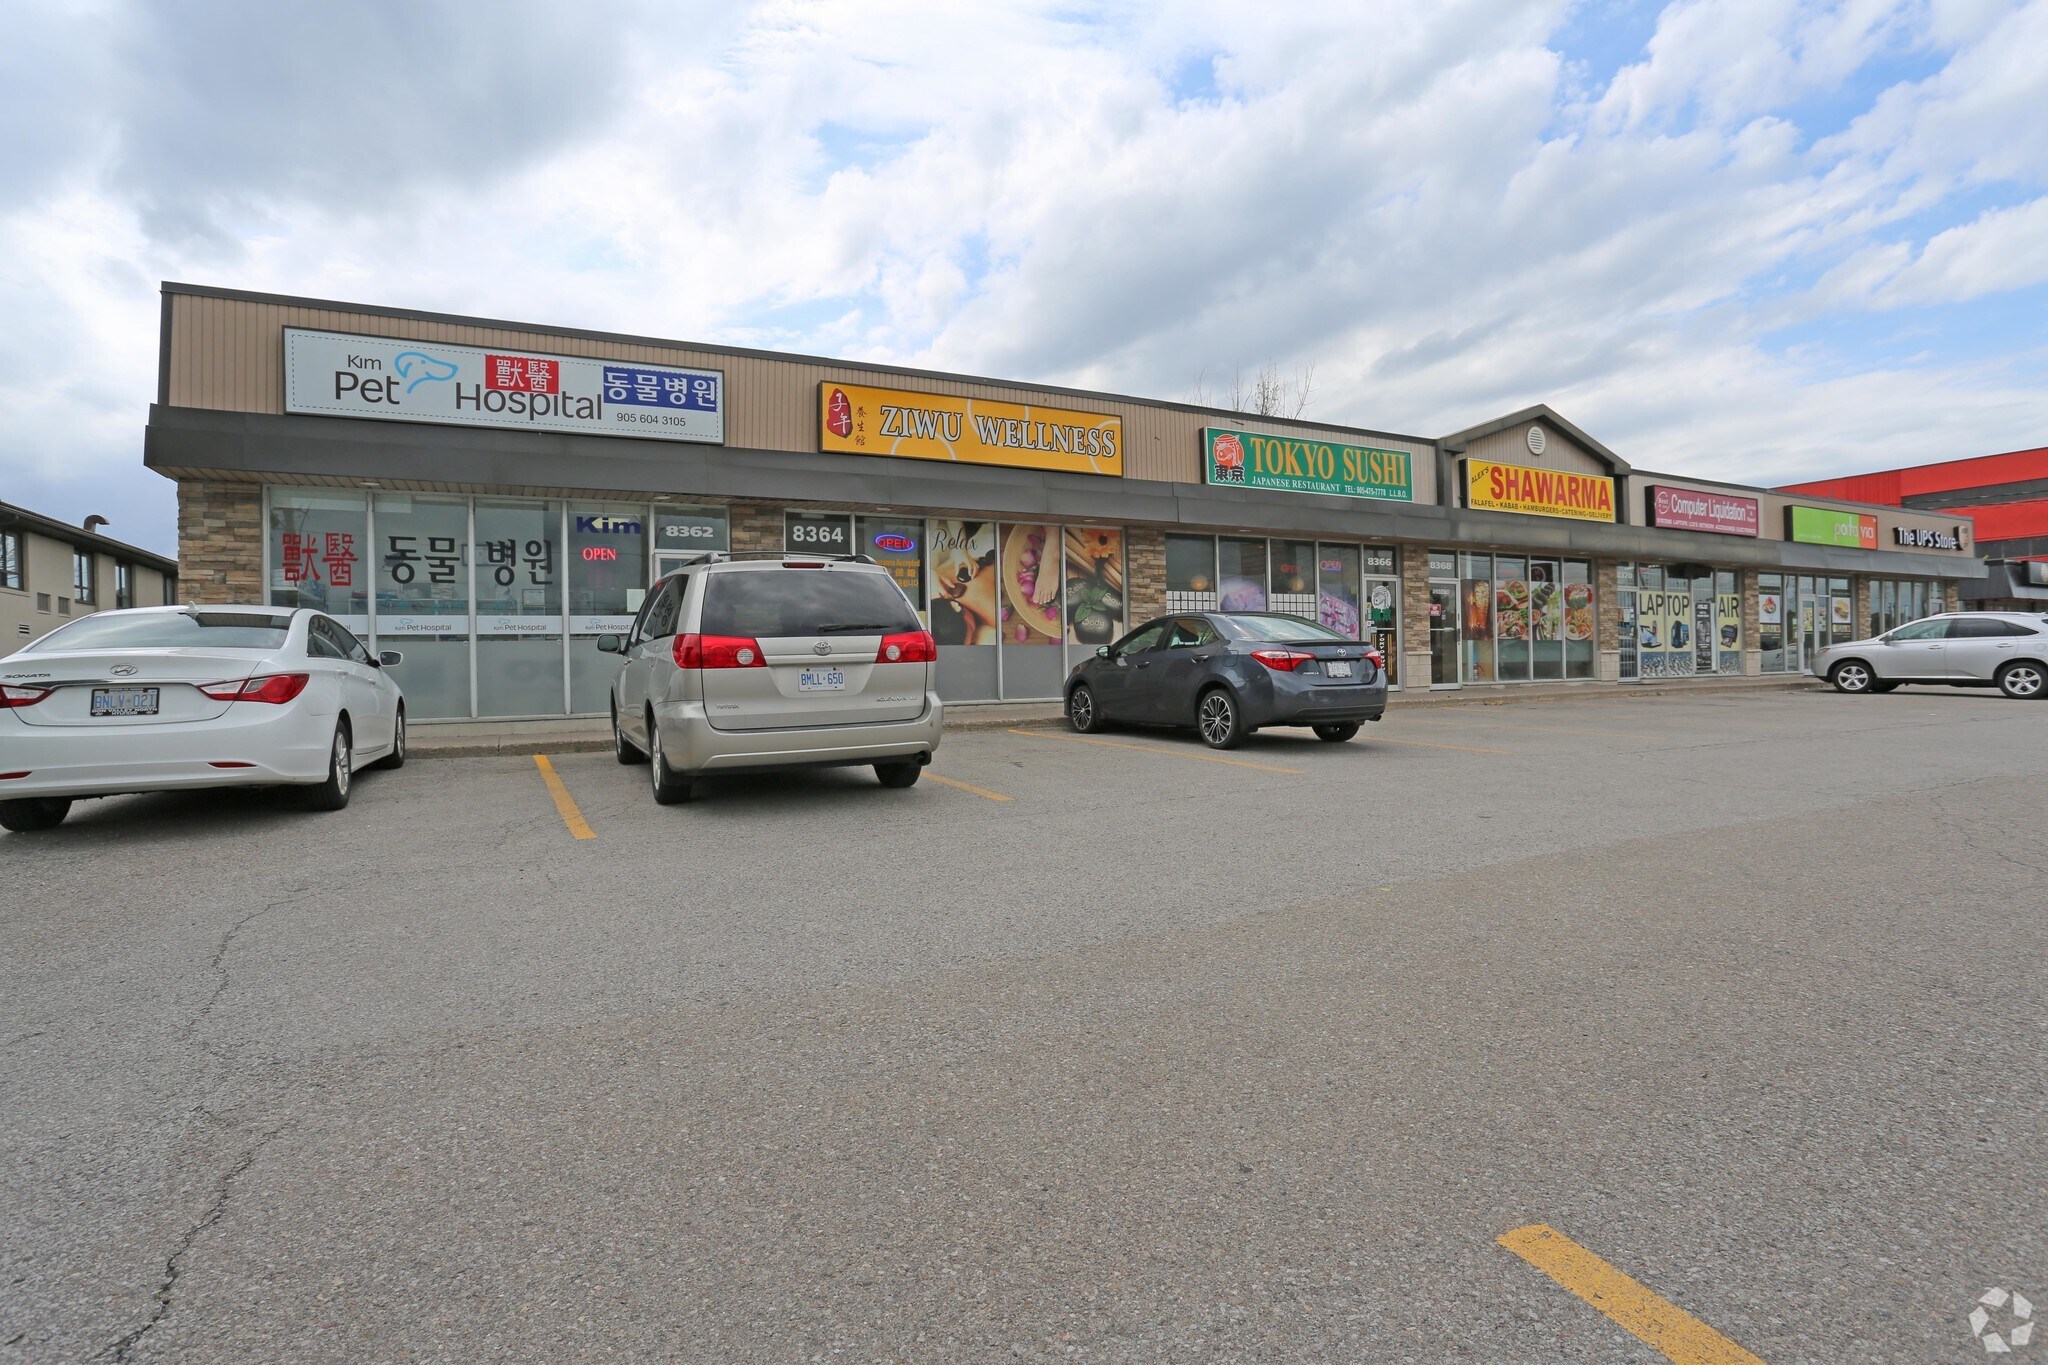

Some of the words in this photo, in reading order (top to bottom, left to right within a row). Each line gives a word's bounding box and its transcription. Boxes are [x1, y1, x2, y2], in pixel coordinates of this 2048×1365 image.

[347, 354, 382, 371] Kim
[496, 360, 552, 392] 獸醫
[335, 371, 400, 405] Pet
[455, 382, 602, 421] Hospital
[604, 371, 716, 407] 동물병원
[616, 412, 637, 424] 905
[639, 413, 659, 425] 604
[661, 414, 686, 427] 3105
[880, 405, 963, 441] ZIWU
[975, 414, 1116, 458] WELLNESS
[1250, 437, 1335, 480] TOKYO
[1343, 449, 1407, 487] SUSHI
[1252, 476, 1290, 488] JAPANESE
[1292, 480, 1340, 492] RESTAURANT
[1471, 466, 1489, 485] ALEX'S
[1490, 465, 1611, 512] SHAWARMA
[1471, 499, 1495, 508] FALAFEL
[1671, 494, 1707, 519] Computer
[1708, 499, 1746, 522] Liquidation
[576, 516, 641, 534] Kim
[665, 525, 714, 538] 8362
[793, 526, 843, 543] 8364
[877, 538, 911, 549] OPEN
[932, 528, 977, 551] Relax
[1898, 526, 1915, 546] The
[1916, 528, 1934, 547] UPS
[1935, 531, 1957, 549] Store
[282, 532, 358, 586] 獸醫
[385, 536, 460, 585] 동물
[486, 540, 553, 586] 병원
[582, 547, 616, 560] OPEN
[1367, 557, 1392, 566] 8366
[1430, 561, 1452, 570] 8368
[1639, 594, 1690, 617] LAPTOP
[1718, 597, 1740, 619] AIR
[420, 624, 452, 632] Hospital
[517, 624, 547, 632] Hospital
[608, 624, 633, 632] Hospita
[827, 672, 844, 684] 650
